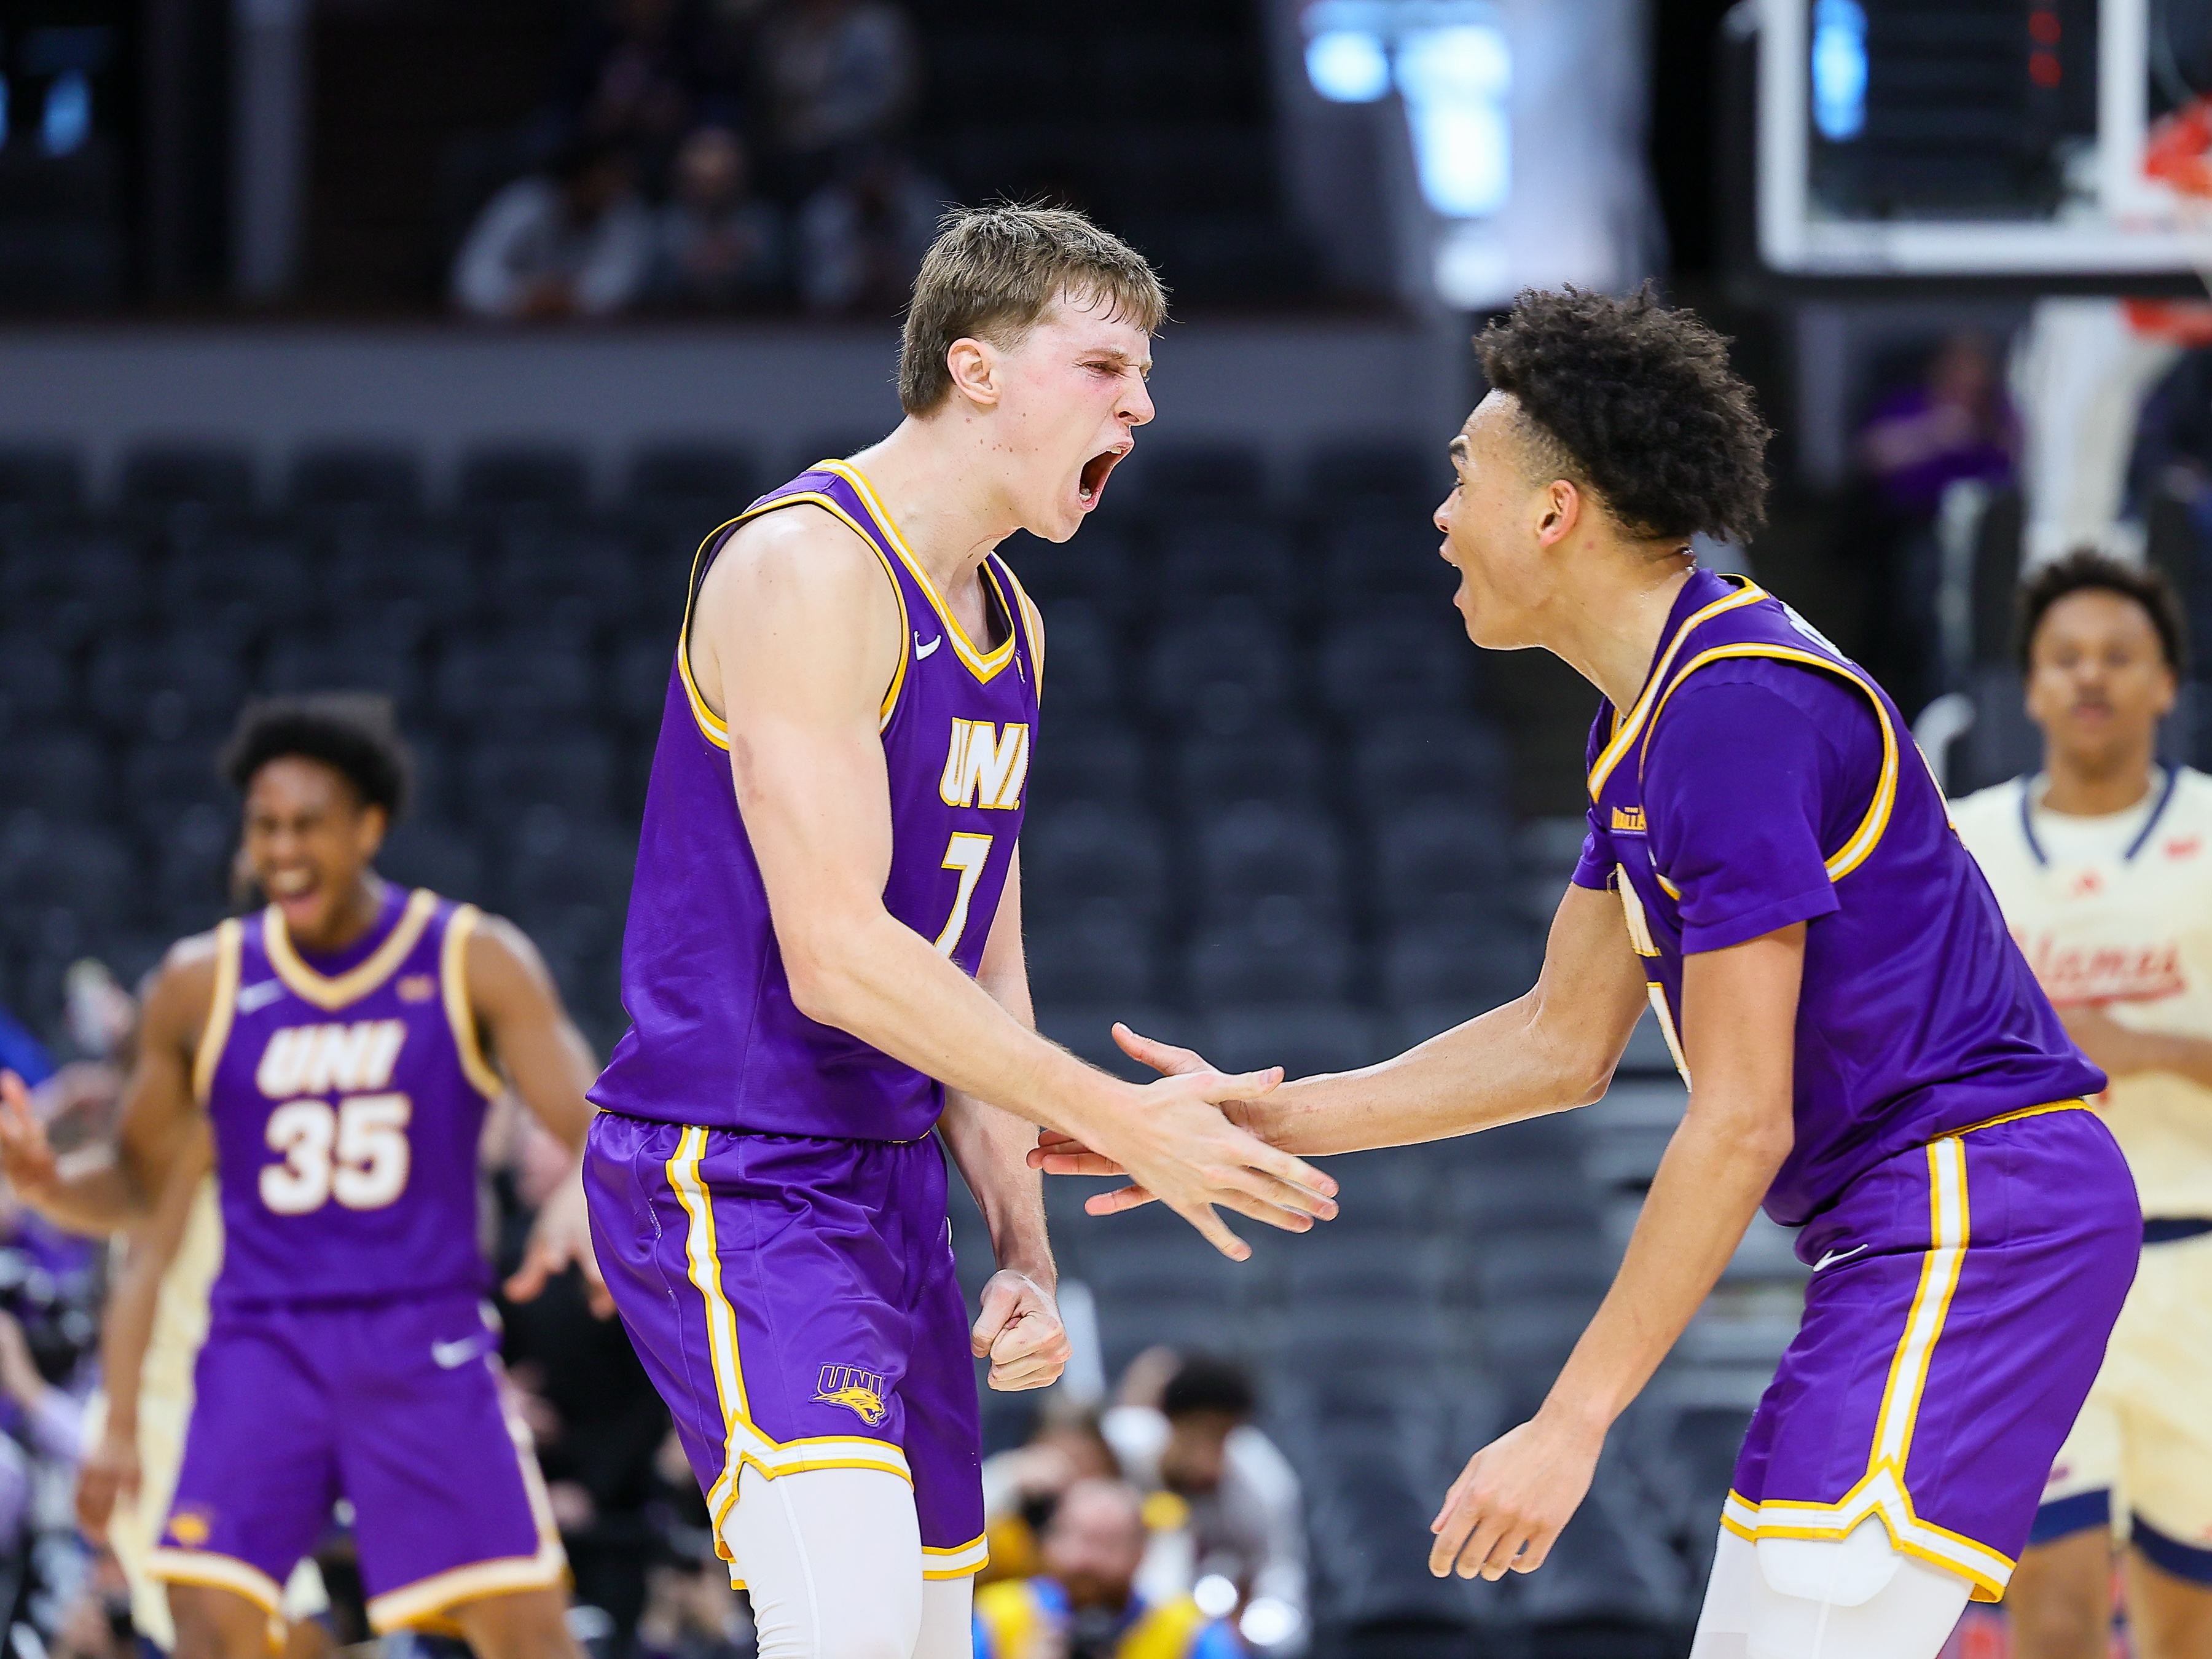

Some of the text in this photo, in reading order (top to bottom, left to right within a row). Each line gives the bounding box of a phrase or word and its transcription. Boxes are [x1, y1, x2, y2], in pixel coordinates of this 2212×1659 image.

[939, 717, 1030, 810] UNI
[933, 831, 994, 959] 7
[256, 1017, 409, 1100] UNI
[258, 1091, 414, 1217] 35
[817, 1365, 883, 1398] UNI
